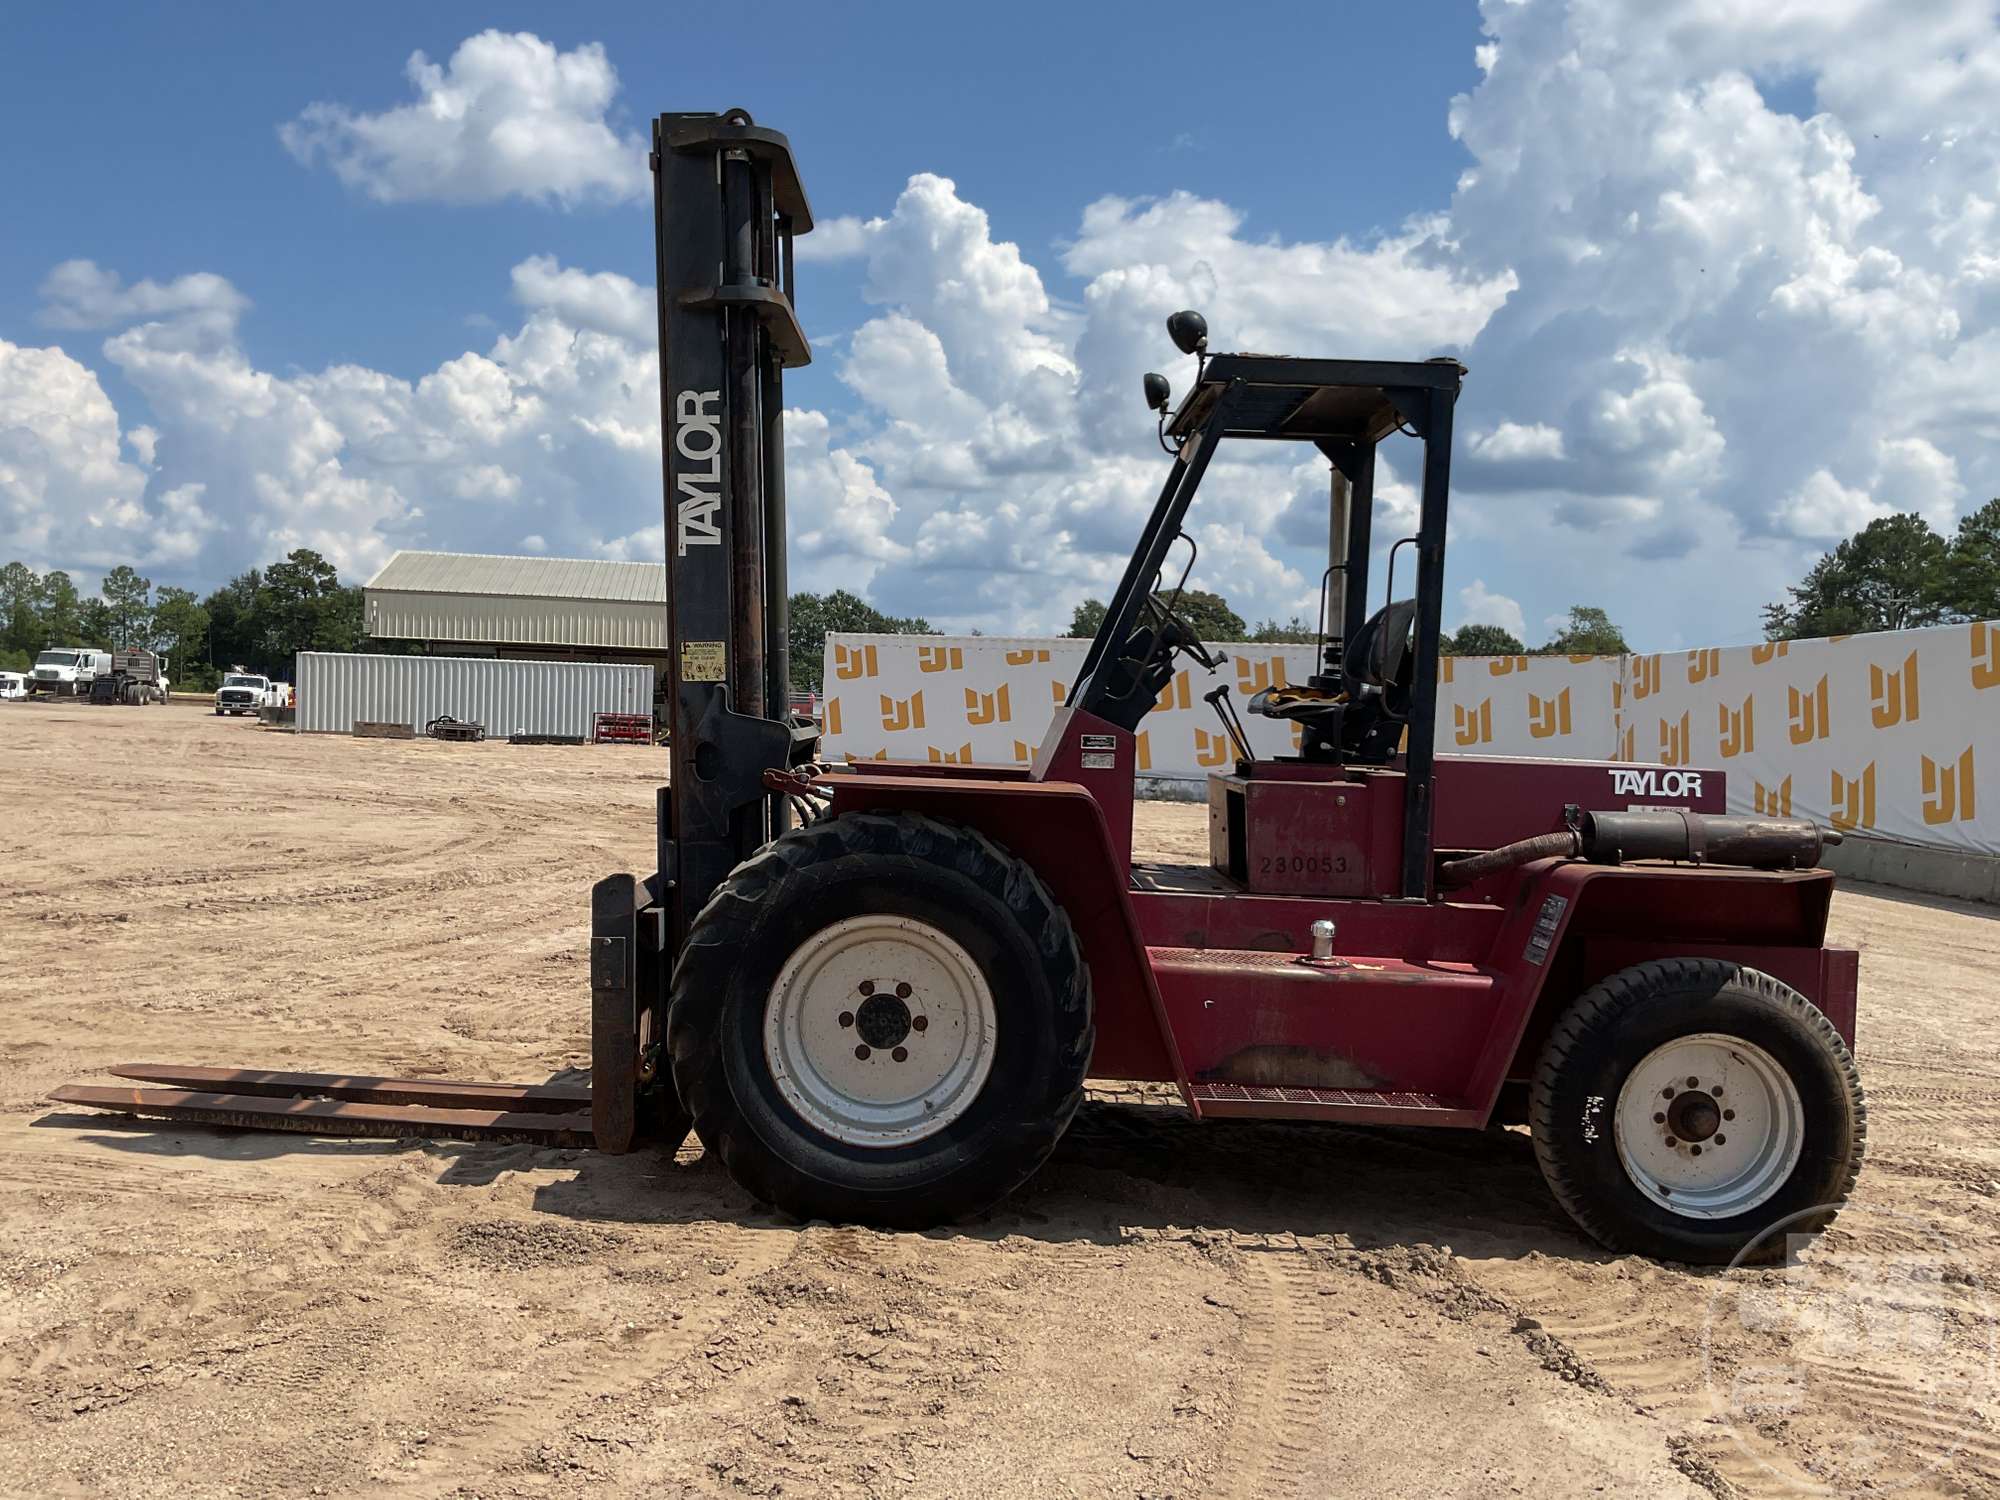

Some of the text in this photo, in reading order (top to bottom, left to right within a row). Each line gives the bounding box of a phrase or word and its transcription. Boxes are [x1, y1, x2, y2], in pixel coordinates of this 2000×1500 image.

[676, 390, 721, 556] TAYLOR
[1608, 769, 1702, 797] TAYLOR
[1260, 856, 1347, 874] 230053
